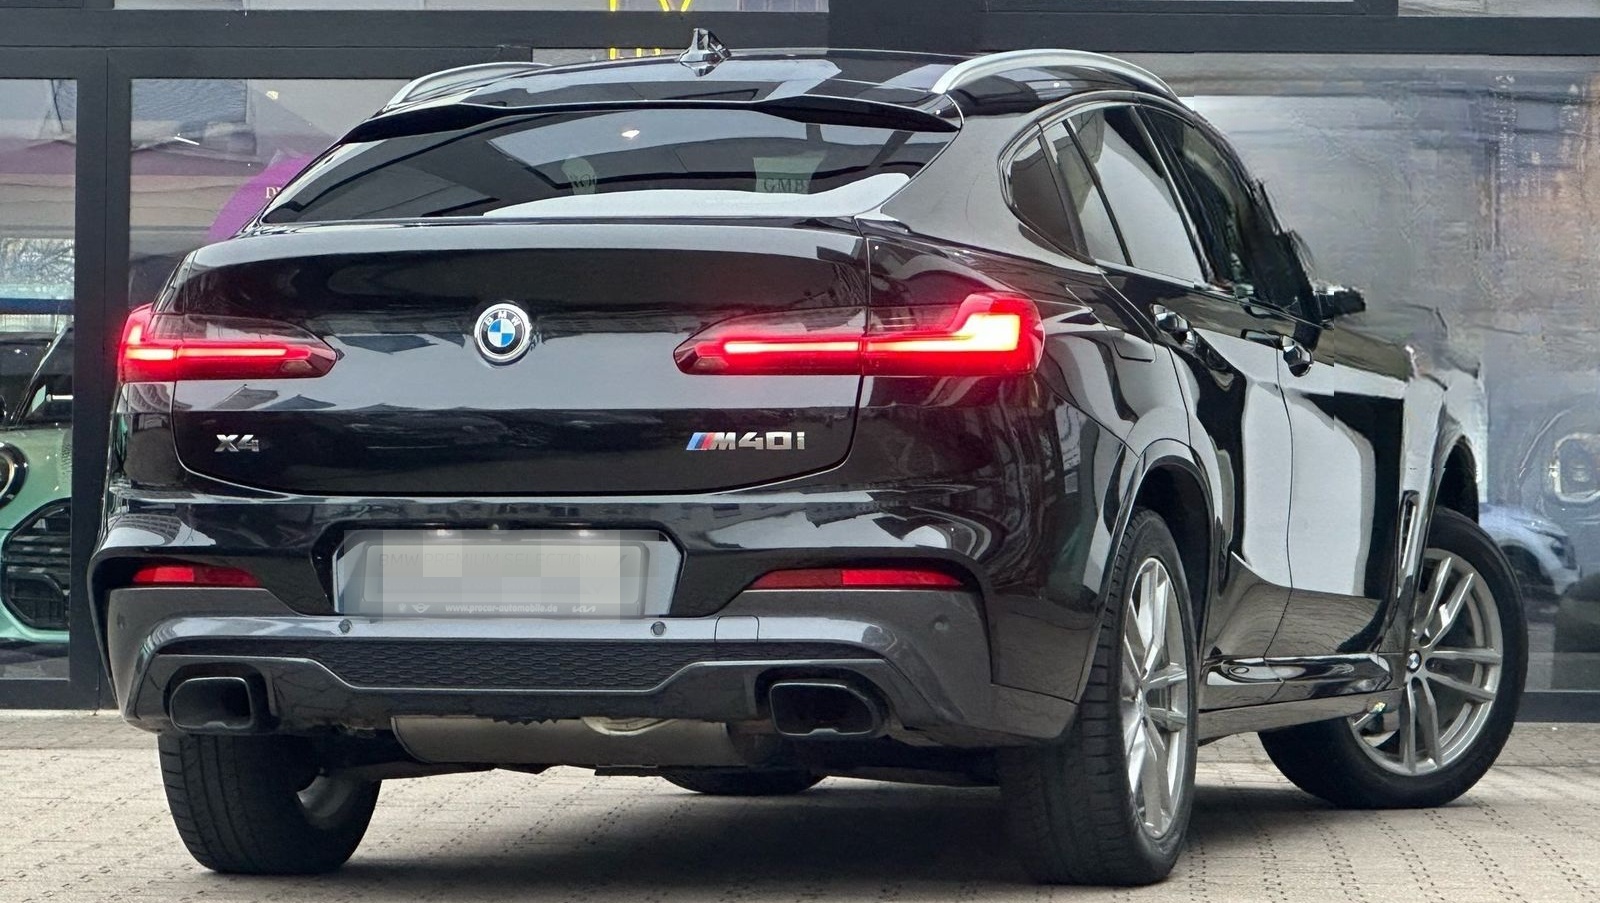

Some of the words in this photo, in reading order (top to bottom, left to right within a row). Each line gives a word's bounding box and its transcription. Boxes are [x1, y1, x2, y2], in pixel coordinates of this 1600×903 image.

[483, 310, 521, 326] BMW
[214, 434, 260, 452] X4
[702, 431, 805, 450] M40i
[379, 553, 418, 567] BMW
[424, 553, 500, 567] PREMIUM
[445, 604, 558, 614] www.procar-automobile.de
